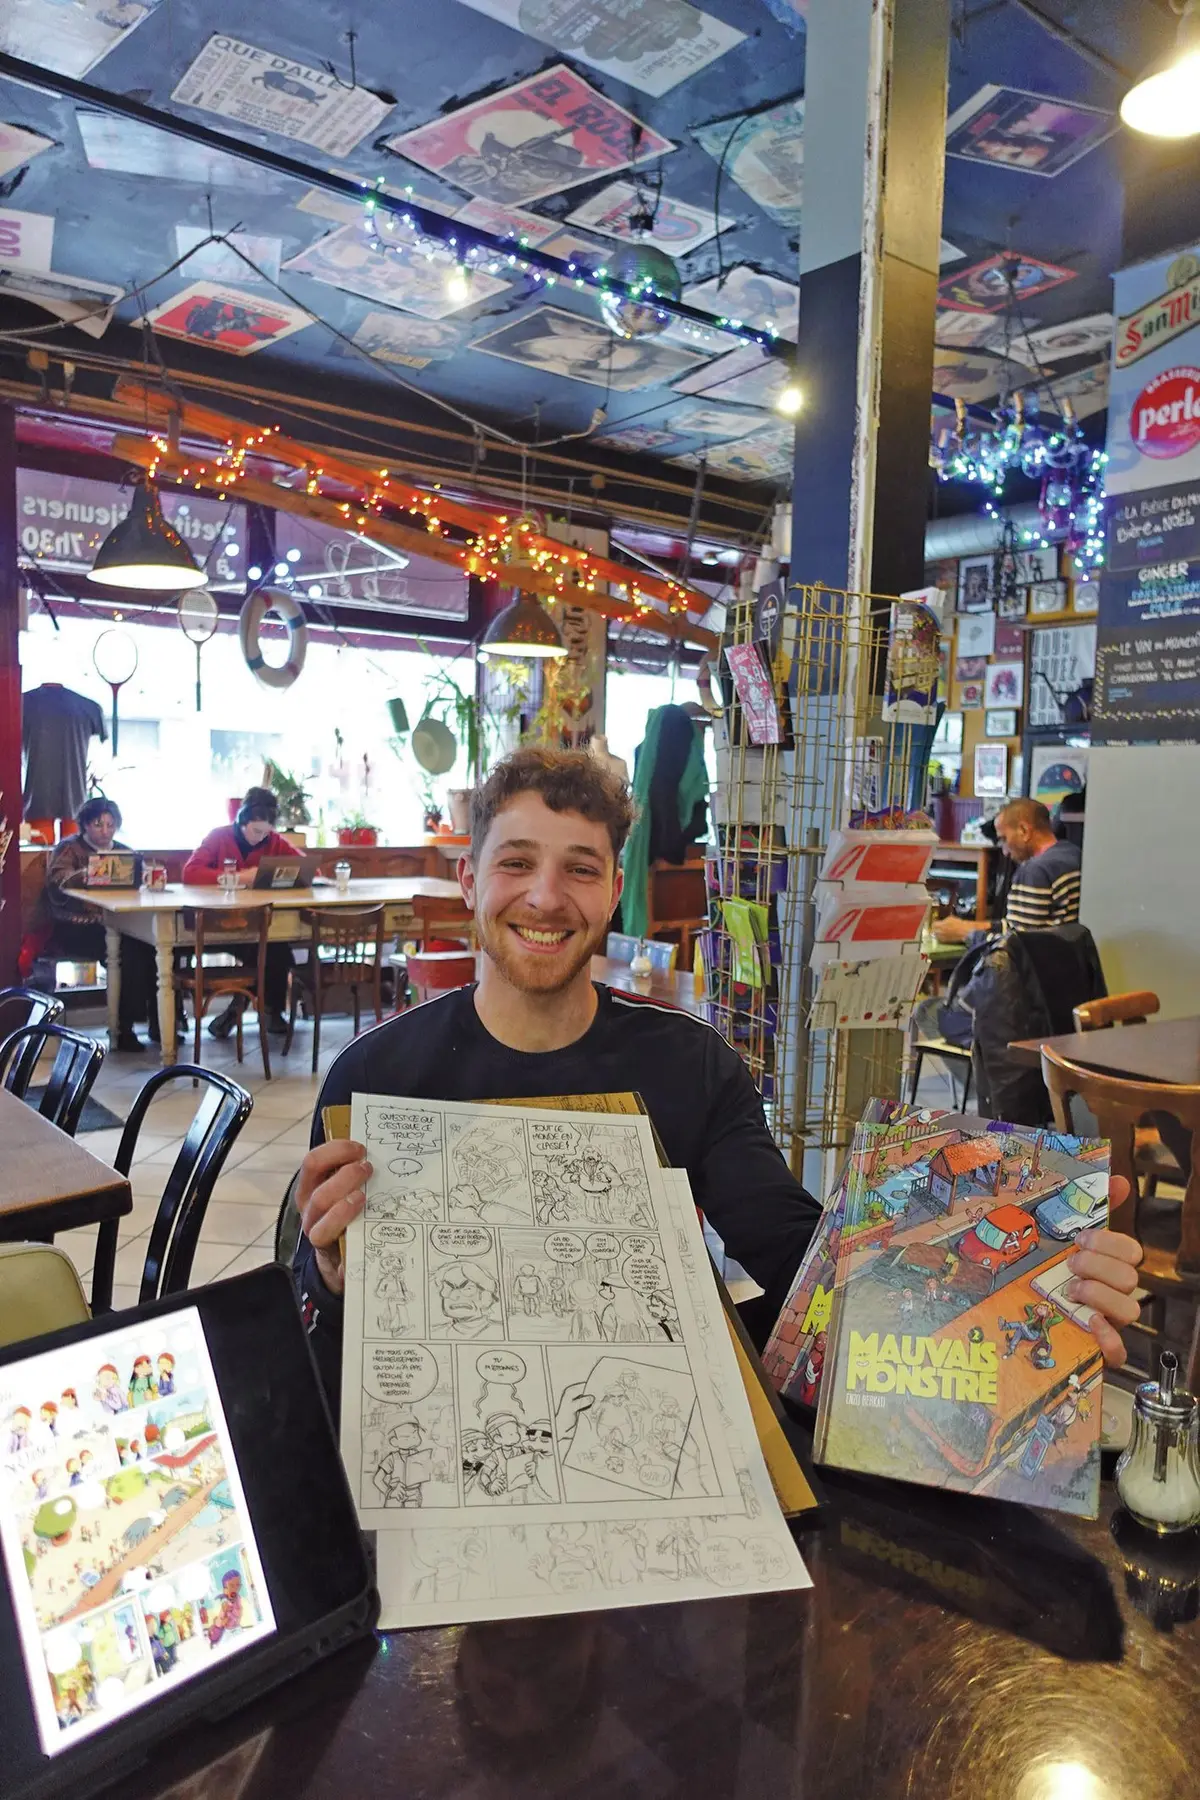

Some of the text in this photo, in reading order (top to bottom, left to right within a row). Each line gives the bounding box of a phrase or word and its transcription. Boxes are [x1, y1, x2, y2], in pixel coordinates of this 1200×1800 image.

[212, 37, 263, 64] QUE
[269, 57, 343, 93] DALLE
[1138, 561, 1189, 582] GINGER
[1119, 641, 1131, 656] LE
[1134, 639, 1153, 654] VIN
[847, 1330, 998, 1373] MAUVAIS
[845, 1358, 998, 1405] MONSTRE
